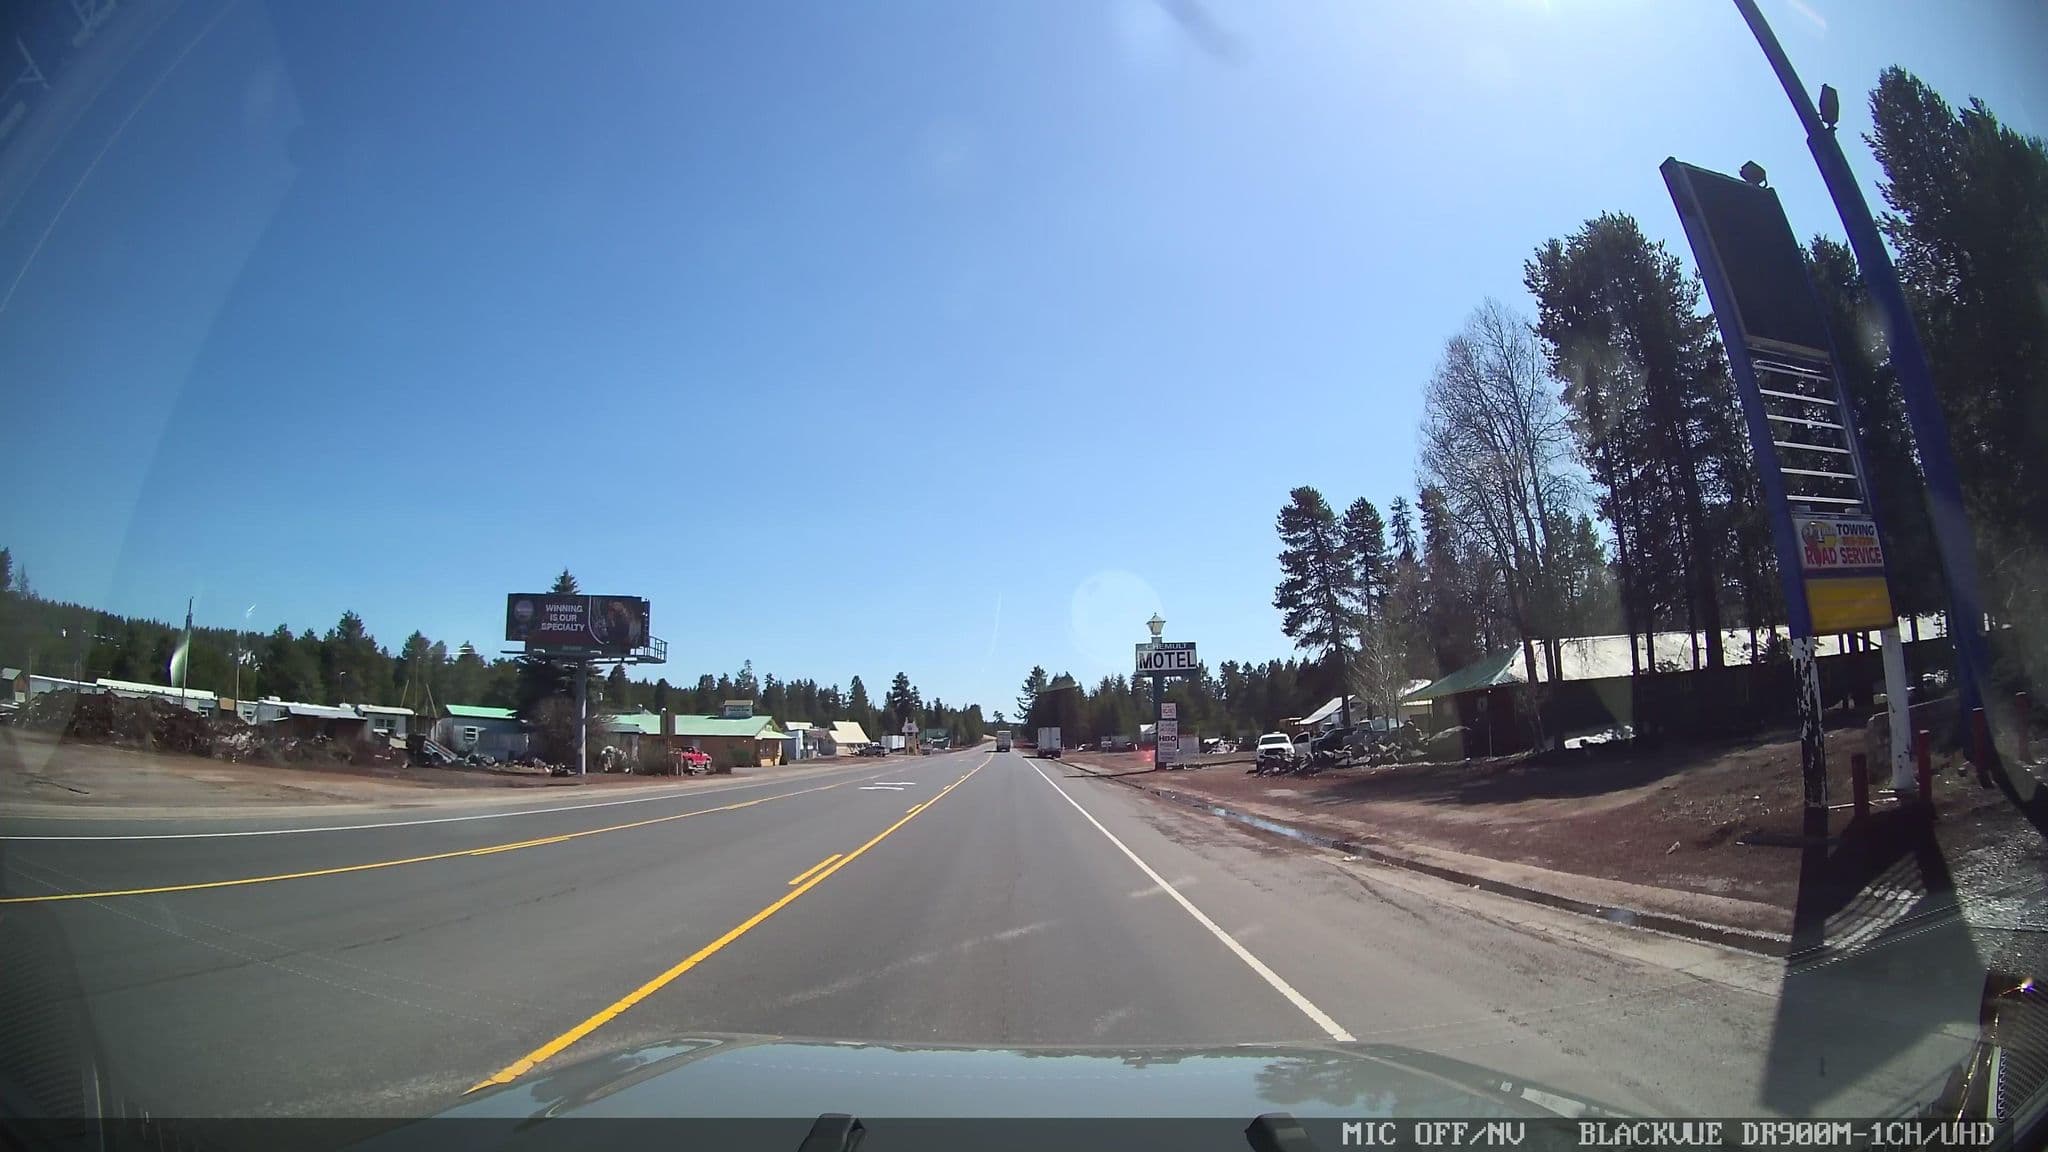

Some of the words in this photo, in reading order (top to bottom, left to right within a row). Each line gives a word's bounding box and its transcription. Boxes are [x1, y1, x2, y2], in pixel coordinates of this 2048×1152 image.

[1836, 523, 1875, 536] TOWING
[1804, 546, 1837, 565] ROAD
[1839, 546, 1882, 565] SERVICE
[545, 604, 584, 613] WINNING
[549, 613, 558, 622] IS
[559, 613, 577, 622] OUR
[541, 622, 586, 632] SPECIALTY
[1139, 651, 1197, 669] MOTEL
